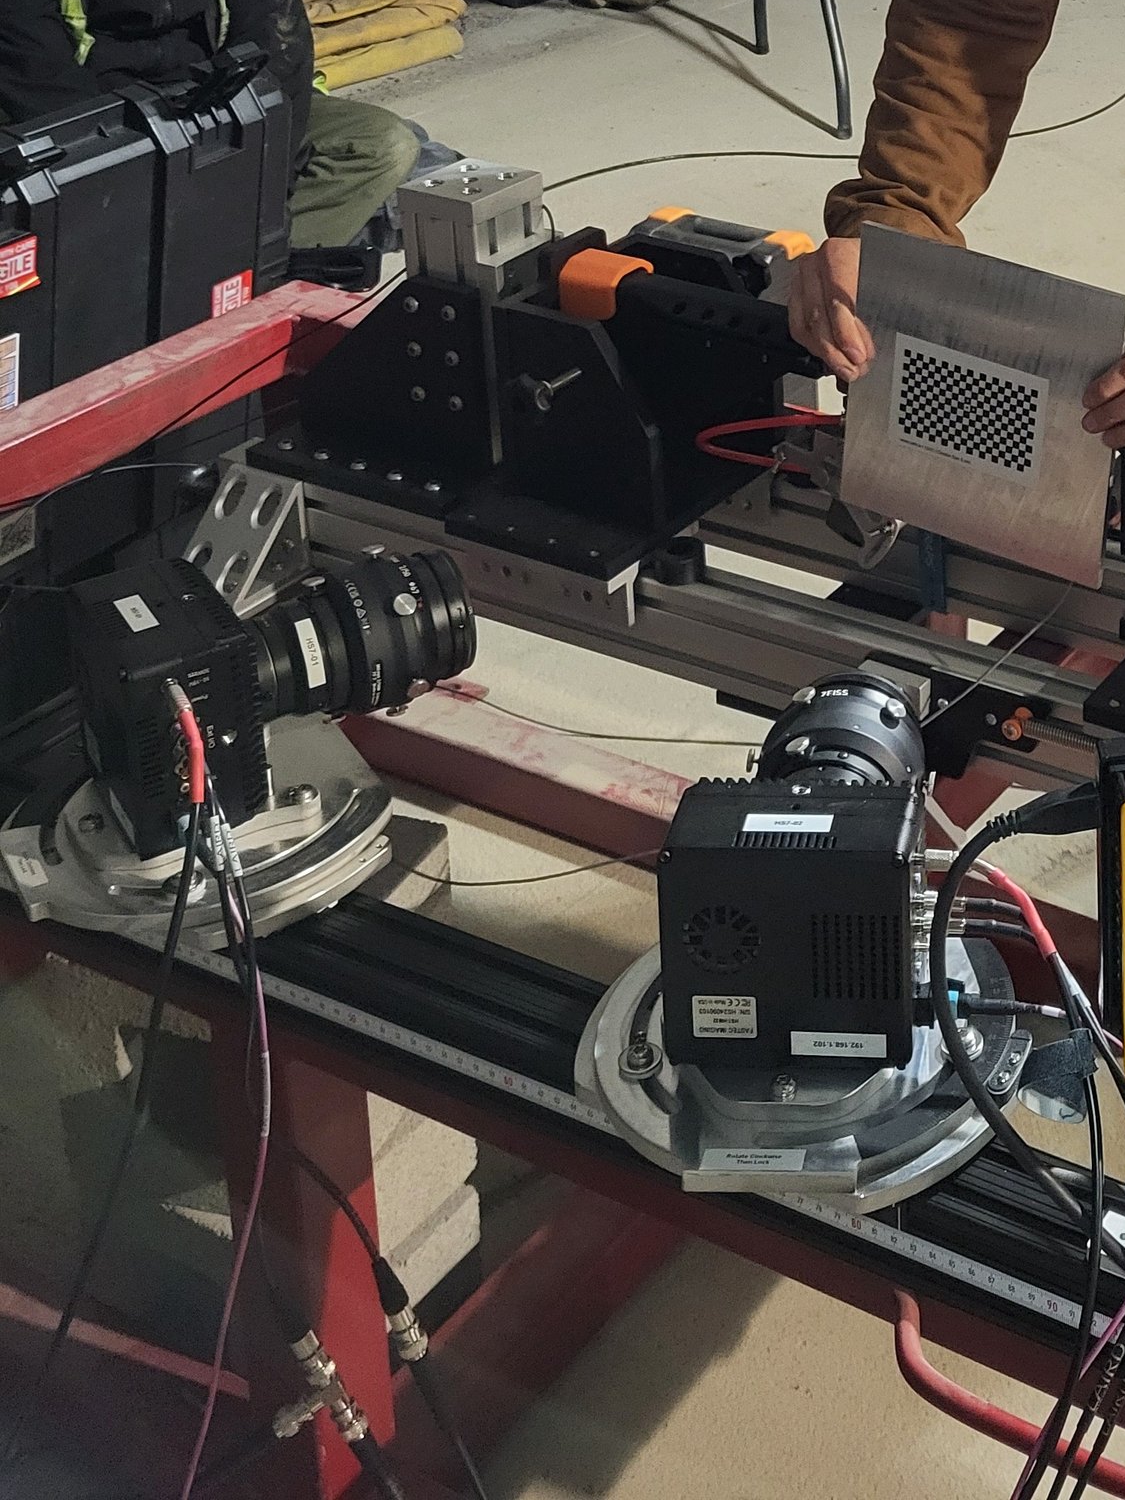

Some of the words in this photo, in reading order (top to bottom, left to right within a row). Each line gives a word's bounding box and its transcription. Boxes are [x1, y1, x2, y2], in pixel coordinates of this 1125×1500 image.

[305, 637, 319, 667] HS7-01
[813, 1041, 864, 1049] 192.168.1.102
[1047, 1299, 1058, 1312] 90
[1089, 1343, 1125, 1413] LAIRD
